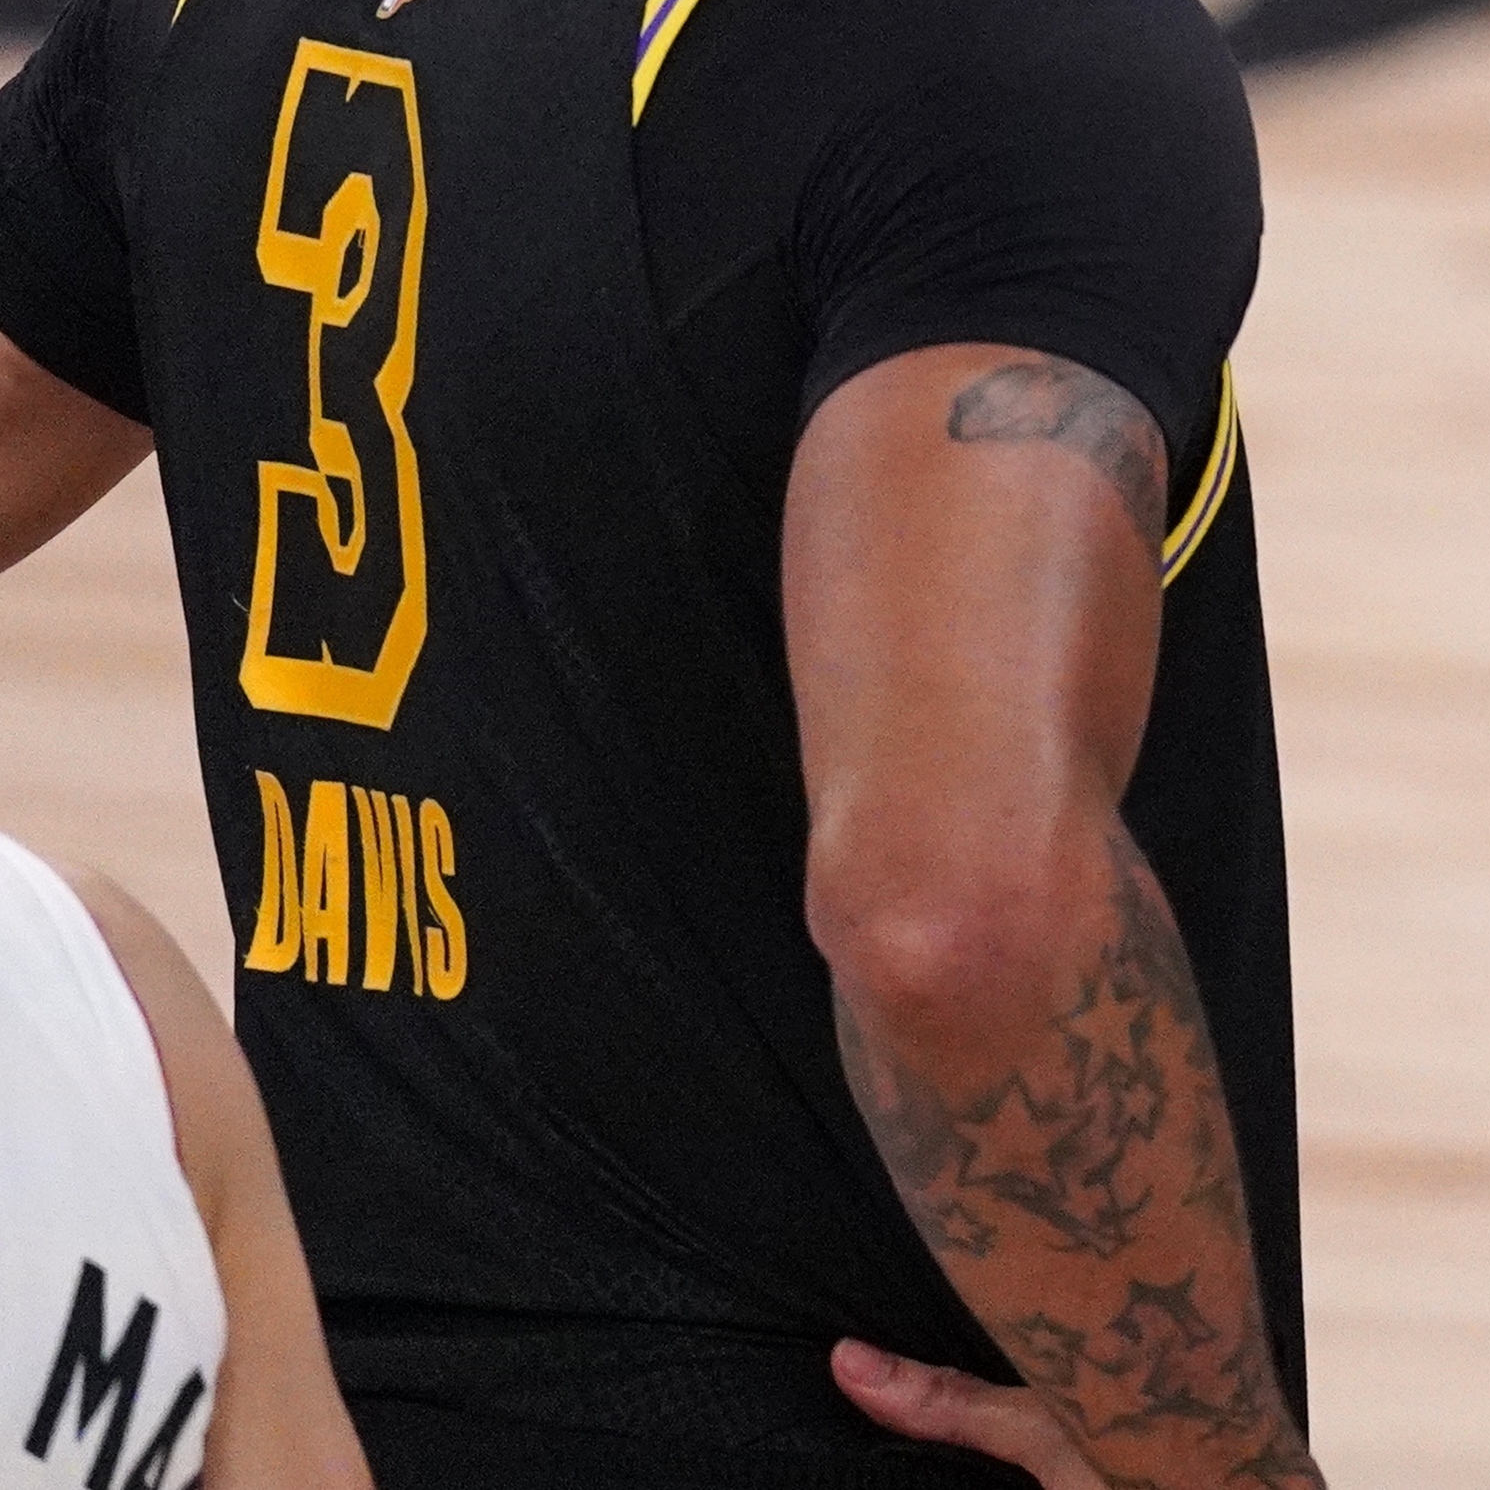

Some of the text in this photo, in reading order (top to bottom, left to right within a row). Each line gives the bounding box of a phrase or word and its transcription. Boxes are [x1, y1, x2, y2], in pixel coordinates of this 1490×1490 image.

[238, 36, 429, 732] 3
[243, 769, 469, 1001] DAVIS
[23, 1256, 206, 1490] MA
